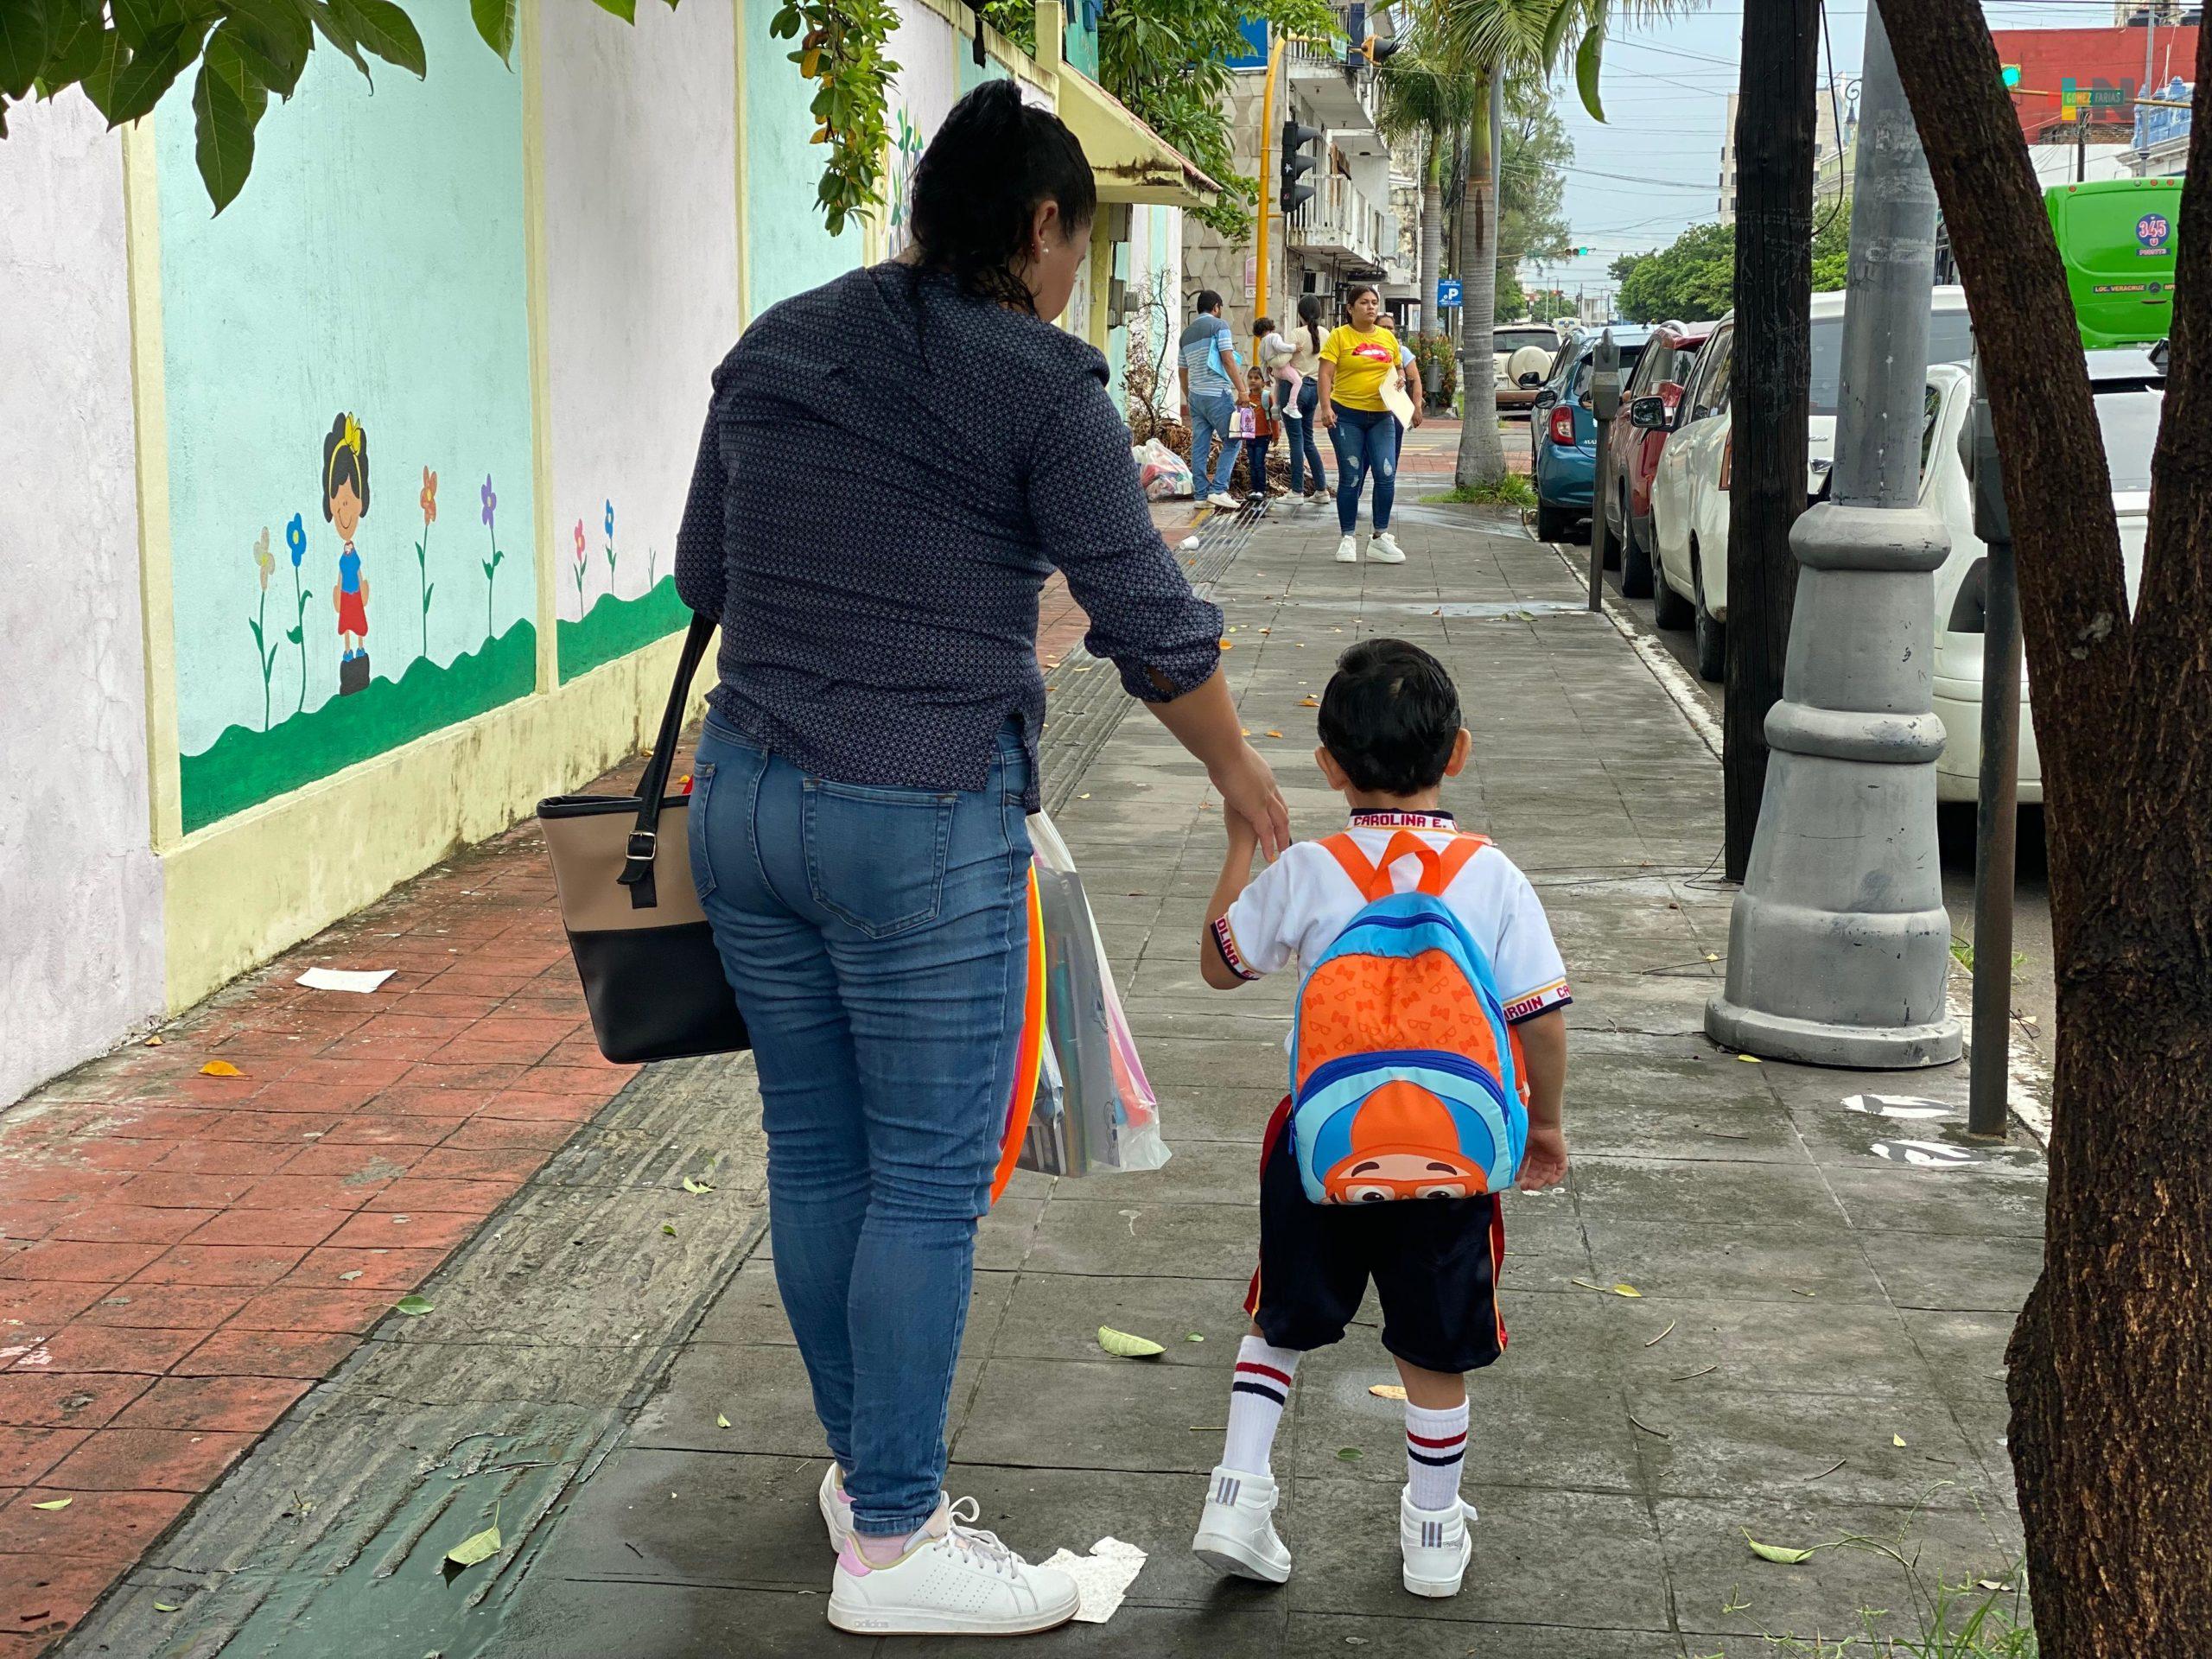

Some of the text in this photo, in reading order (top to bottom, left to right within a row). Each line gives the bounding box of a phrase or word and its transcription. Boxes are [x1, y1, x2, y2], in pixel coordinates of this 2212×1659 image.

[2139, 219, 2166, 238] 345
[1448, 288, 1459, 300] P
[1353, 814, 1427, 827] CAROLINA
[1433, 817, 1446, 829] E.
[855, 1618, 889, 1629] adidas
